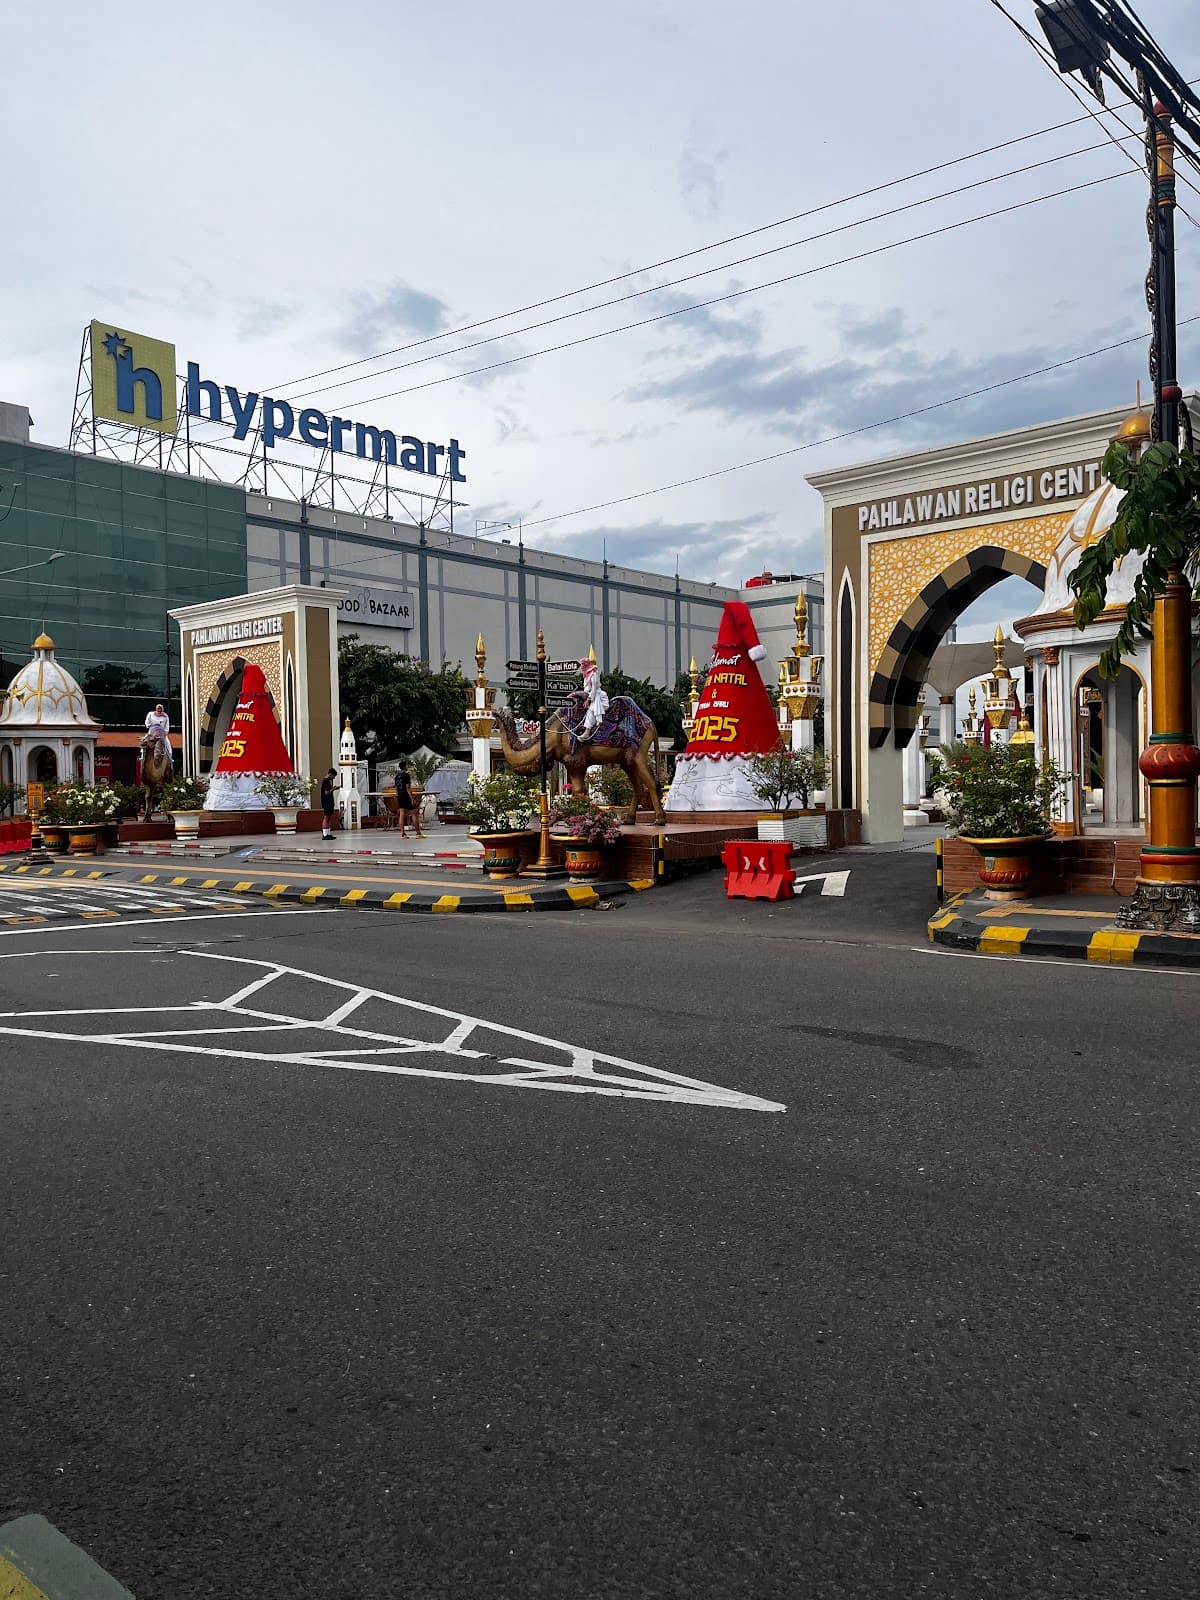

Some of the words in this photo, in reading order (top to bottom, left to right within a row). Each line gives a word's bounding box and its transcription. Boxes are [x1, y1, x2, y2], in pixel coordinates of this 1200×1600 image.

[187, 361, 467, 483] hypermart
[858, 488, 961, 531] PAHLAWAN
[964, 475, 1034, 514] RELIGI
[1039, 461, 1104, 499] CENT
[337, 599, 360, 612] OOD
[369, 600, 410, 618] BAZAAR
[191, 626, 227, 646] PAHLAWAN
[228, 621, 252, 641] RELIGI
[253, 617, 283, 636] CENTER
[547, 663, 562, 672] Balai
[563, 662, 578, 671] Kota
[547, 681, 574, 690] Ka'bah
[713, 673, 748, 686] NATAL
[689, 715, 740, 743] 2025
